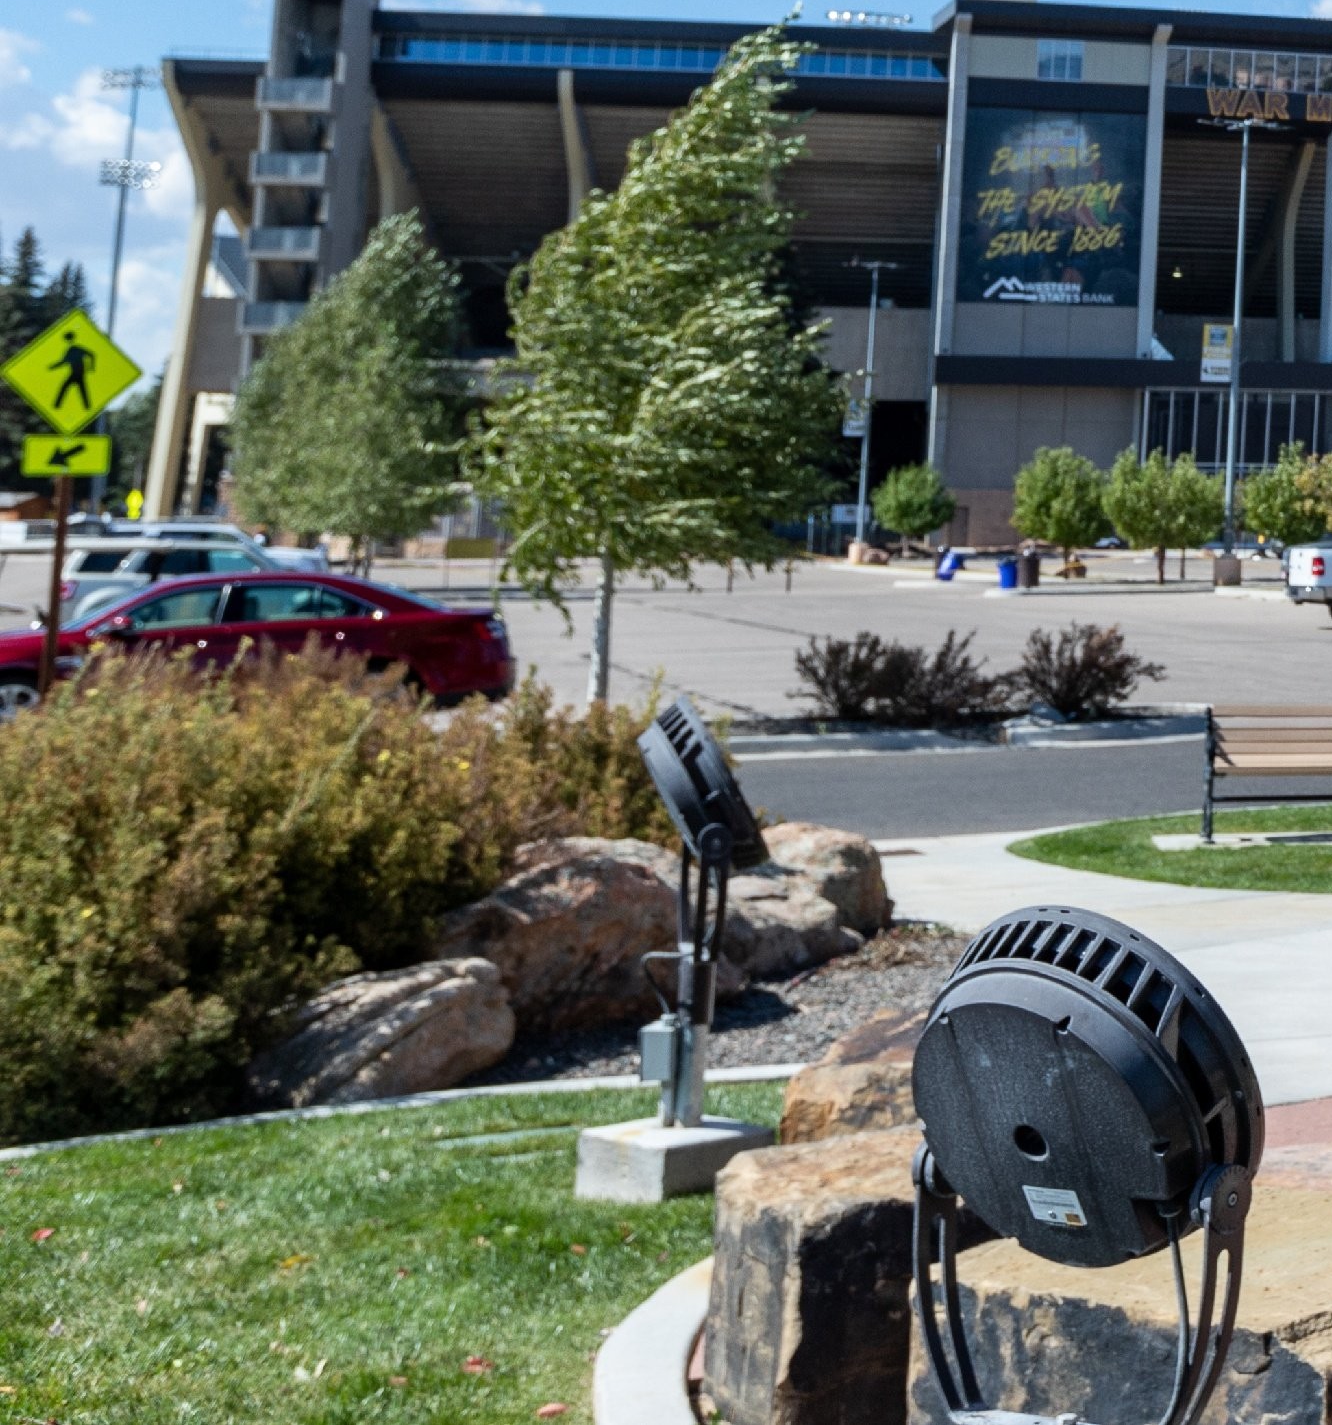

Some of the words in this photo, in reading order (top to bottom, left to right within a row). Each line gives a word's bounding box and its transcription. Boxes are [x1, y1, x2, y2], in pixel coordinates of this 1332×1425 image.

[1207, 88, 1290, 120] WAR
[1028, 181, 1124, 219] SYSTEM
[984, 227, 1064, 260] SINCE
[1023, 282, 1081, 293] WESTERN
[1038, 293, 1081, 303] STATES
[1082, 294, 1115, 304] BANK
